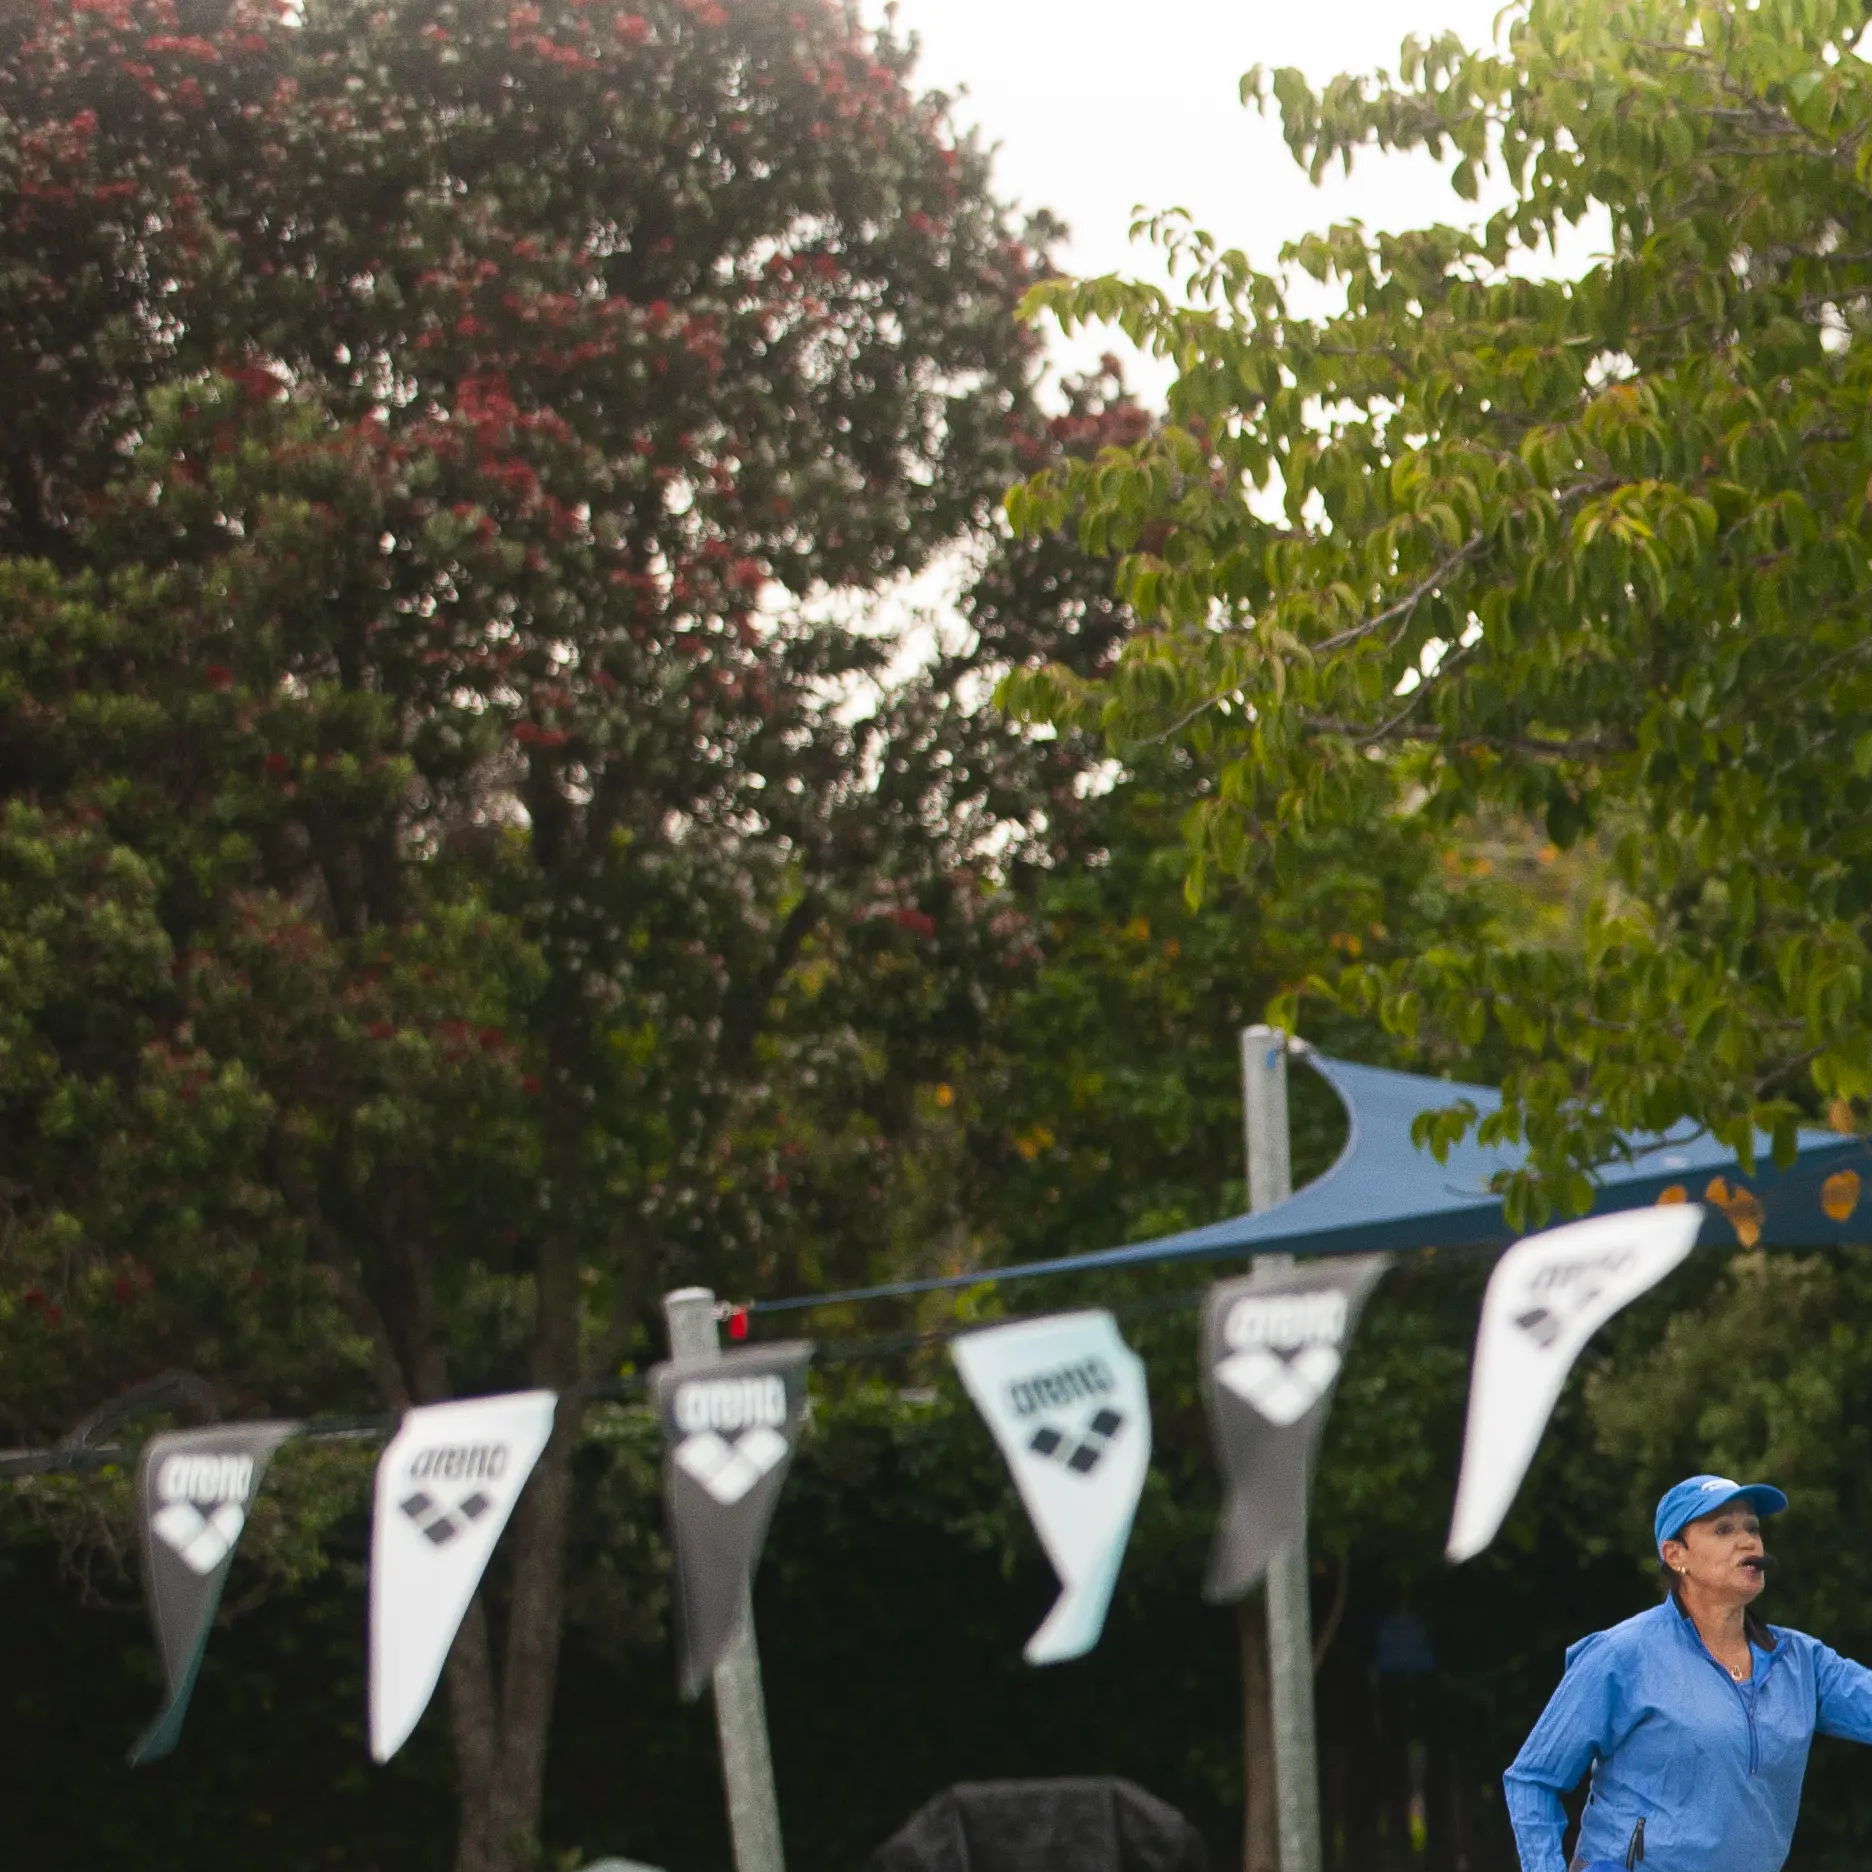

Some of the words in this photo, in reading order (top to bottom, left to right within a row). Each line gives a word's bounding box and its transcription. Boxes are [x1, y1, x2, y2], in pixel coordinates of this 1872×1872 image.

[674, 1375, 786, 1430] arena
[1008, 1357, 1115, 1416] arena
[158, 1453, 253, 1503] arena
[408, 1443, 509, 1480] arena
